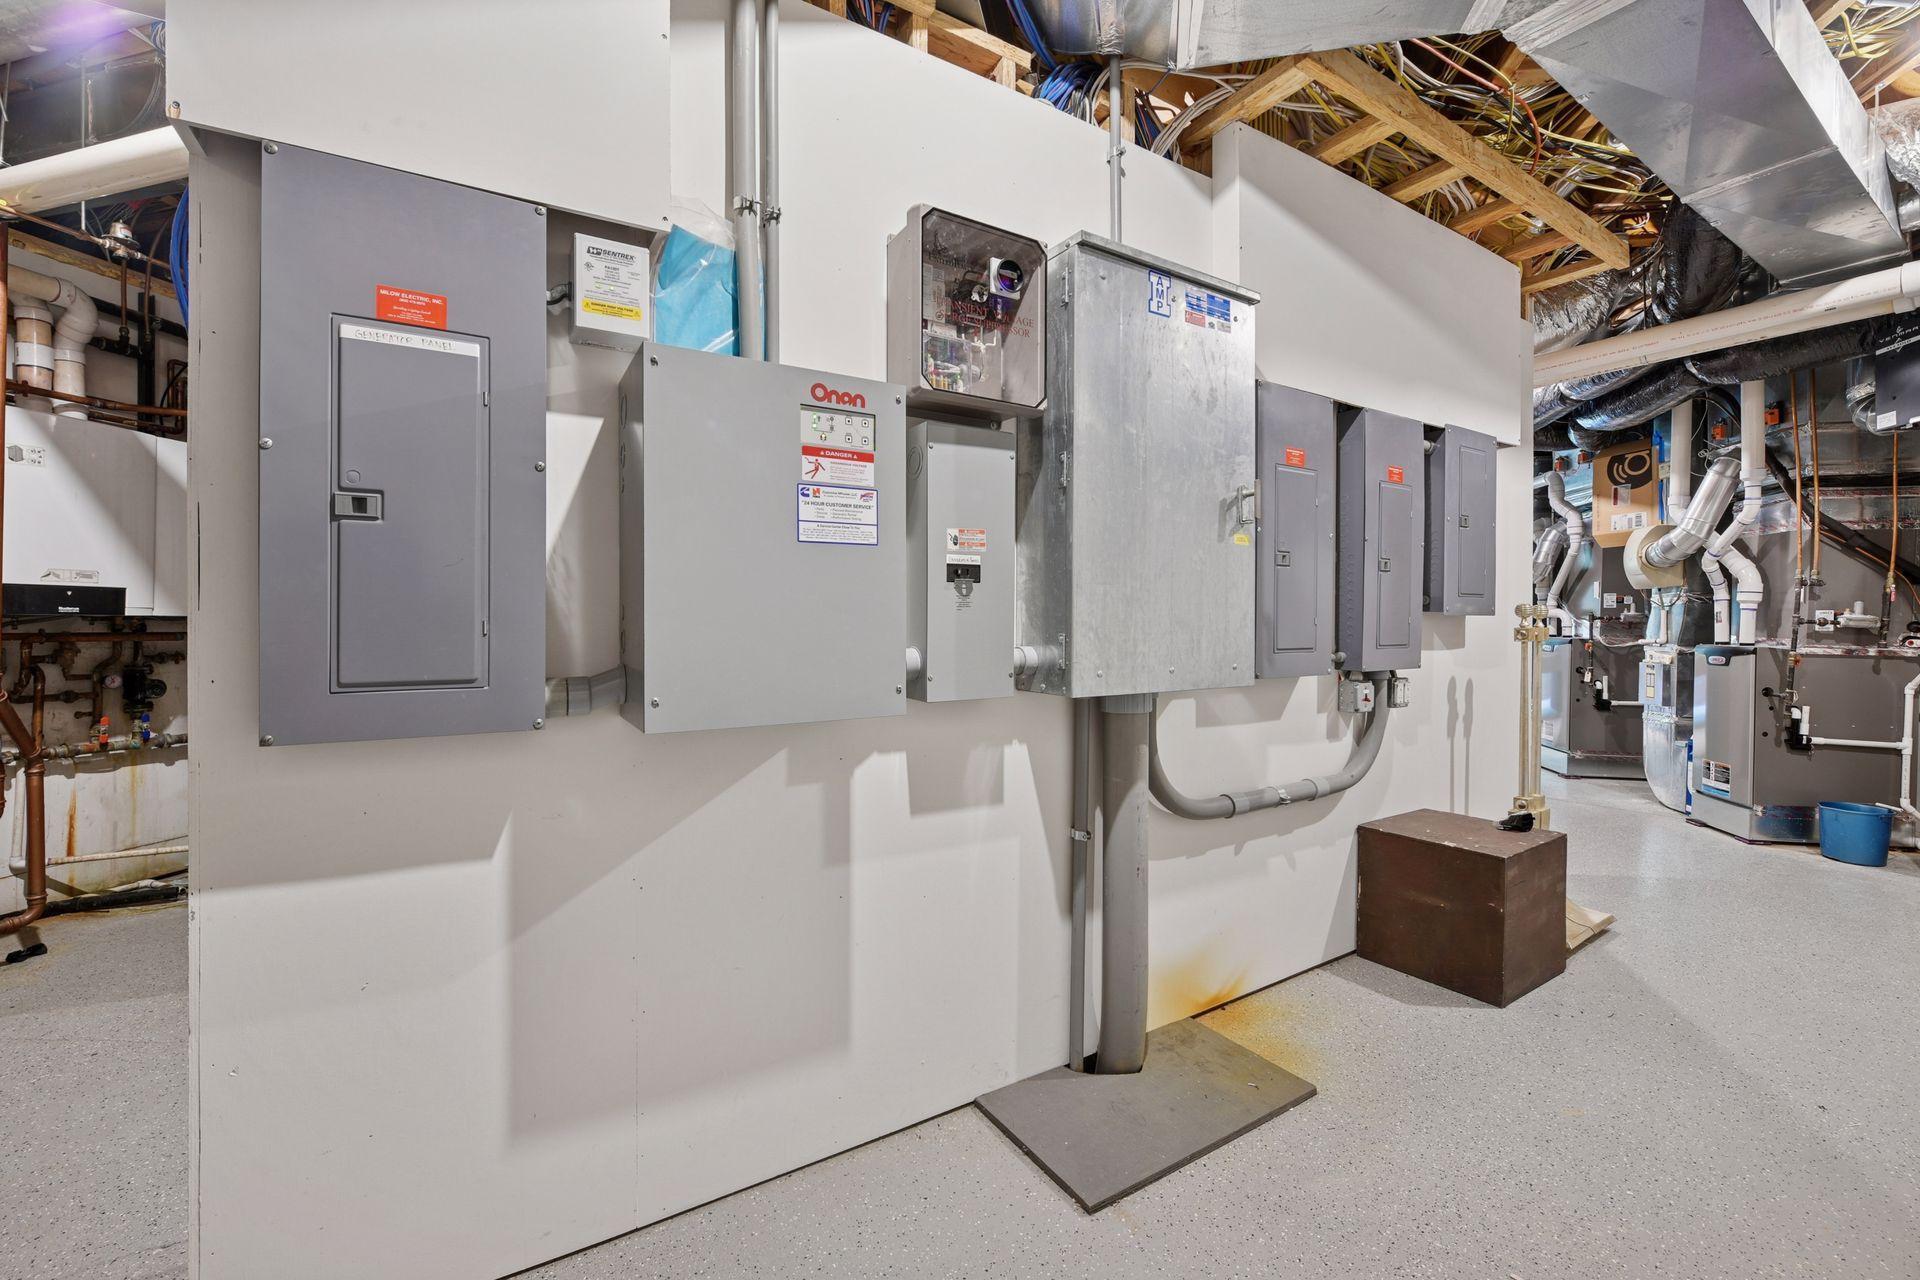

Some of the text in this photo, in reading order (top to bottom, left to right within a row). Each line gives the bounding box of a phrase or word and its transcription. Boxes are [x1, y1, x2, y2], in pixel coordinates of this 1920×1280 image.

[1156, 276, 1164, 311] AMP
[354, 329, 456, 351] GENERATOR PANEL
[810, 383, 866, 408] Onan
[825, 450, 853, 458] DANGER
